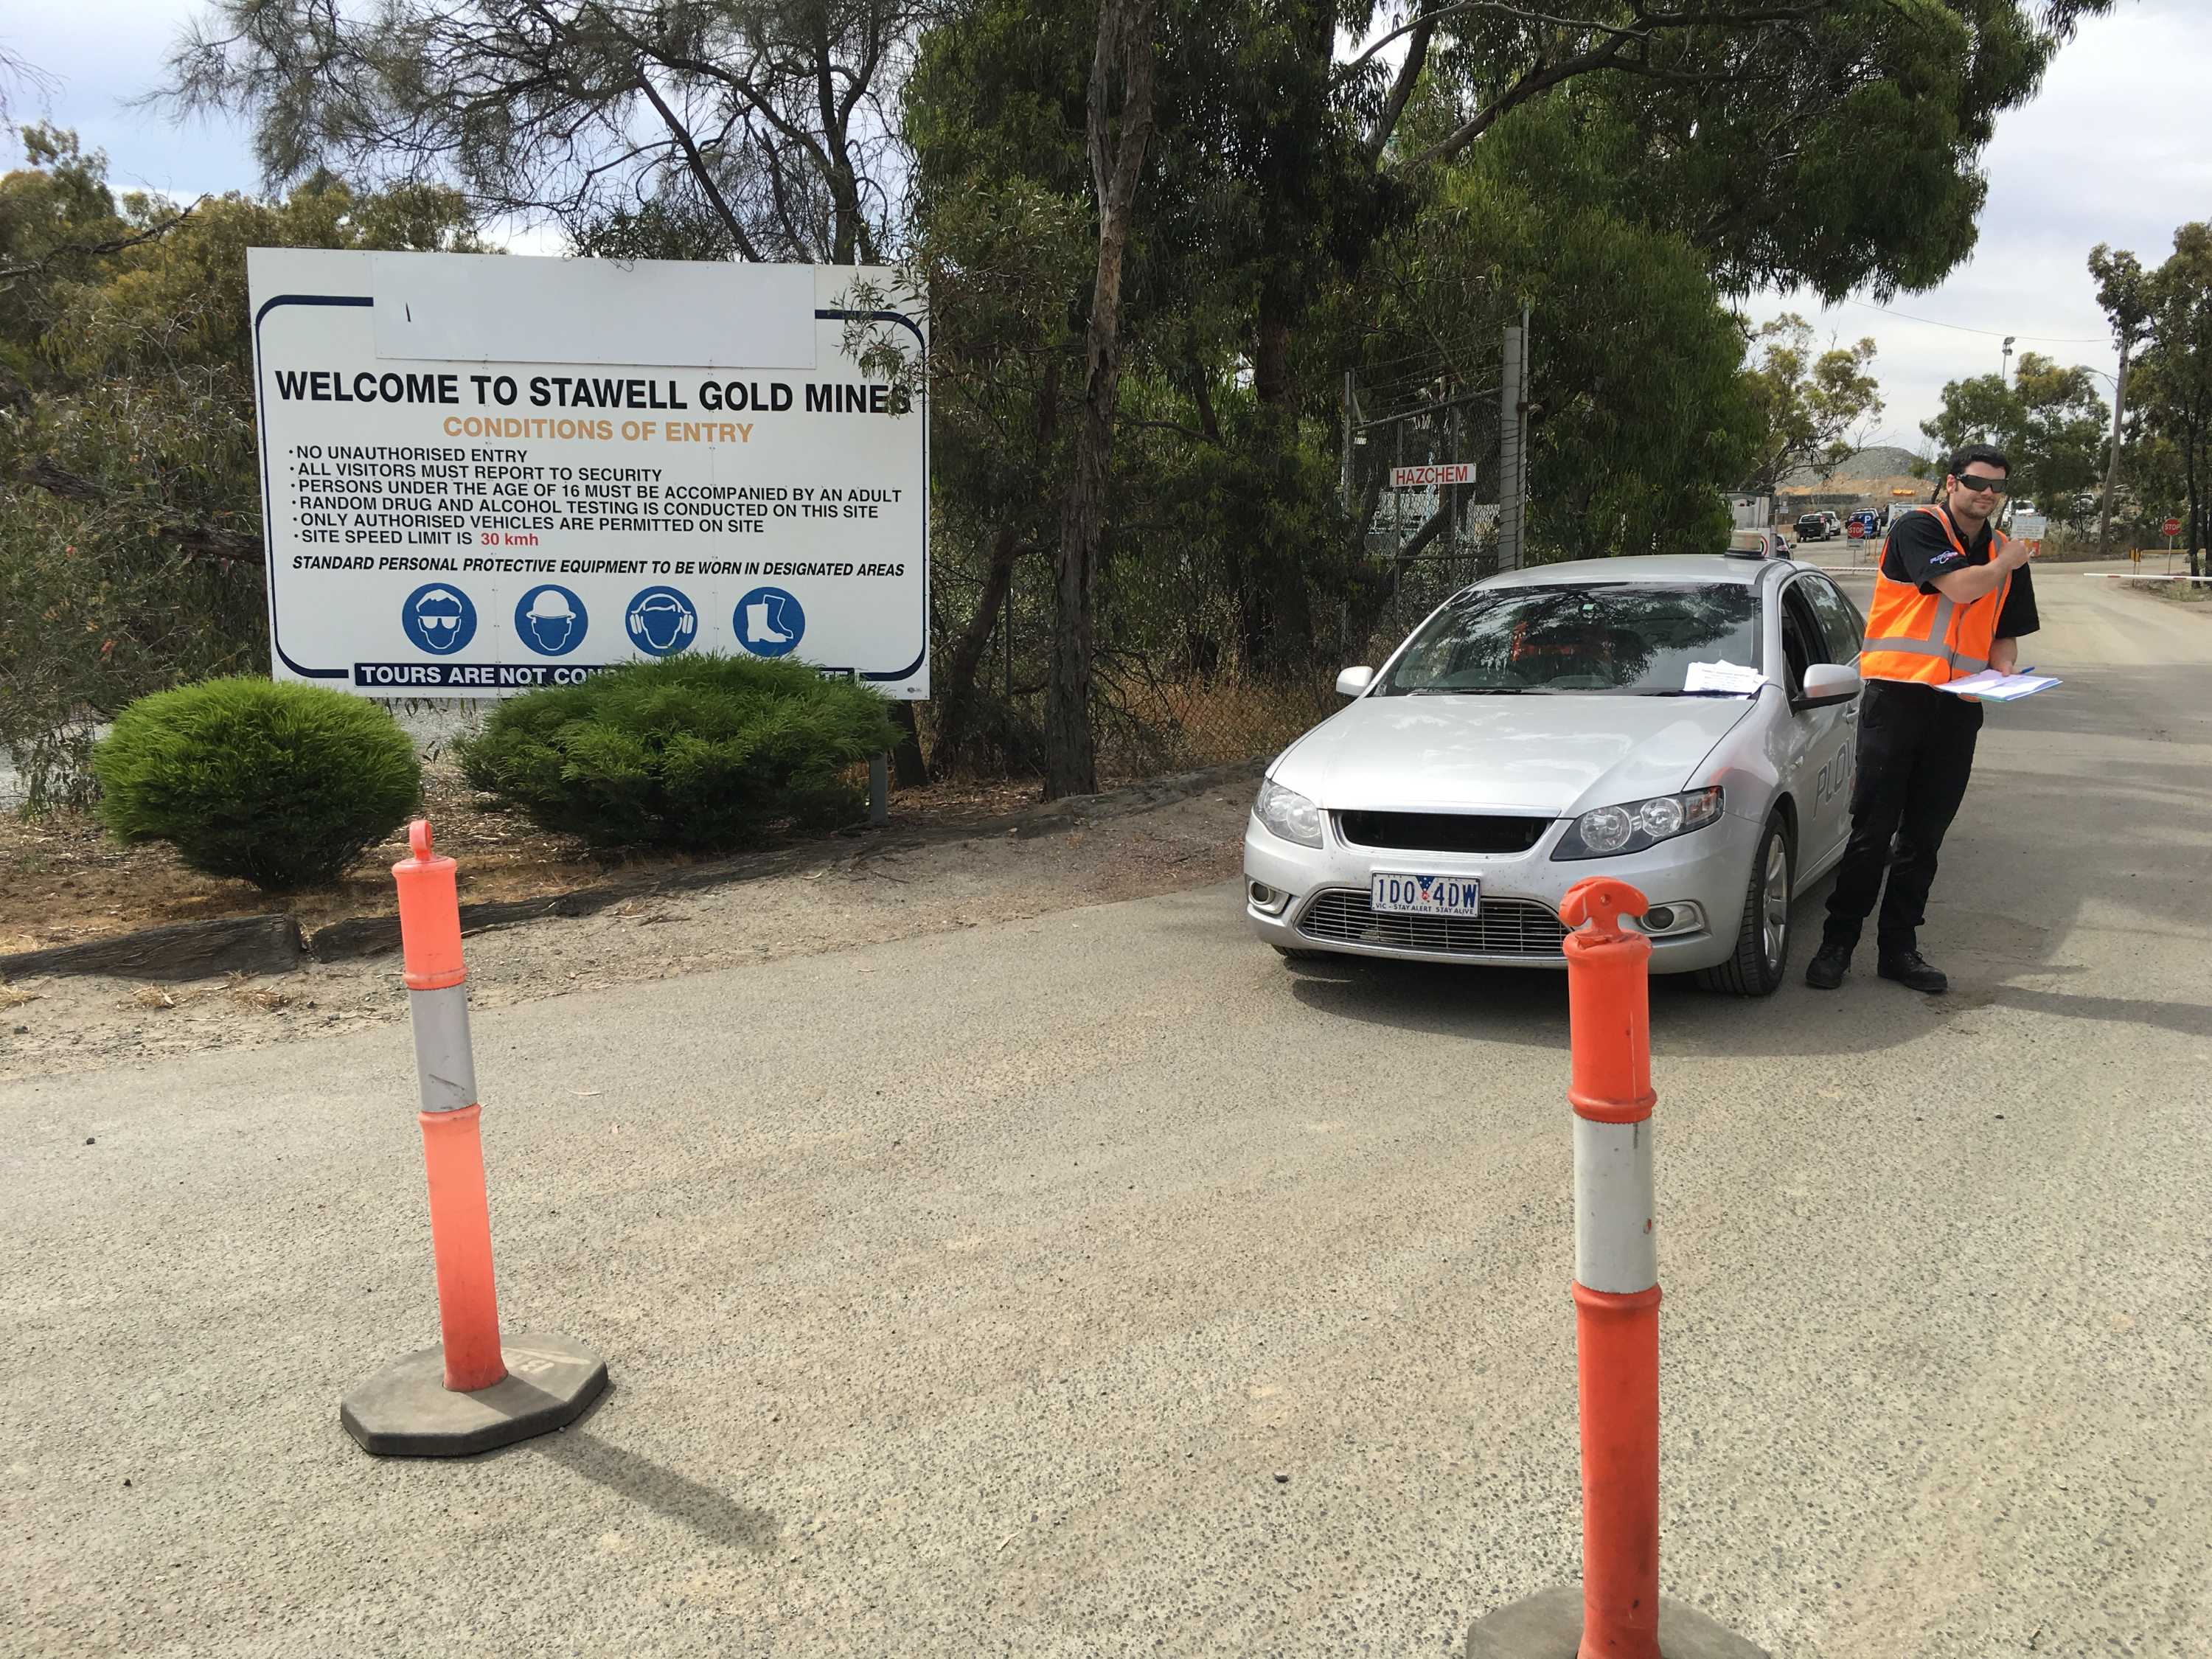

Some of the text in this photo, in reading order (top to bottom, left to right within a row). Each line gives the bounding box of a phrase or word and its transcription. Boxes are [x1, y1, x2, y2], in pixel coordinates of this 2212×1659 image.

[275, 371, 459, 403] WELCOME
[470, 375, 517, 406] TO
[530, 377, 687, 409] STAWELL
[700, 381, 793, 411] GOLD
[444, 417, 753, 442] CONDITIONS OF ENTRY
[297, 445, 527, 462] NO UNAUTHORISED ENTRY
[299, 463, 661, 481] ALL VISITORS MUST REPORT TO SECURITY
[1396, 466, 1467, 485] HAZCHEM
[299, 479, 902, 502] PERSONS UNDER THE AGE OF 16 MUST BE ACCOMPANIED BY AN ADULT
[300, 496, 878, 518] RANDOM DRUG AND ALCOHOL TESTING IS CONDUCTED ON THIS SITE
[301, 513, 764, 532] ONLY AUTHORISED VEHICLES ARE PERMITTED ON SITE
[302, 529, 538, 546] SITE SPEED LIMIT IS 30 kmh
[293, 556, 904, 576] STANDARD PERSONAL PROTECTIVE EQUIPMENT TO BE WORN IN DESIGNATED AREAS
[361, 667, 440, 683] TOURS
[449, 668, 494, 683] ARE
[501, 668, 546, 684] NOT
[1379, 879, 1477, 908] 1DO 4DW
